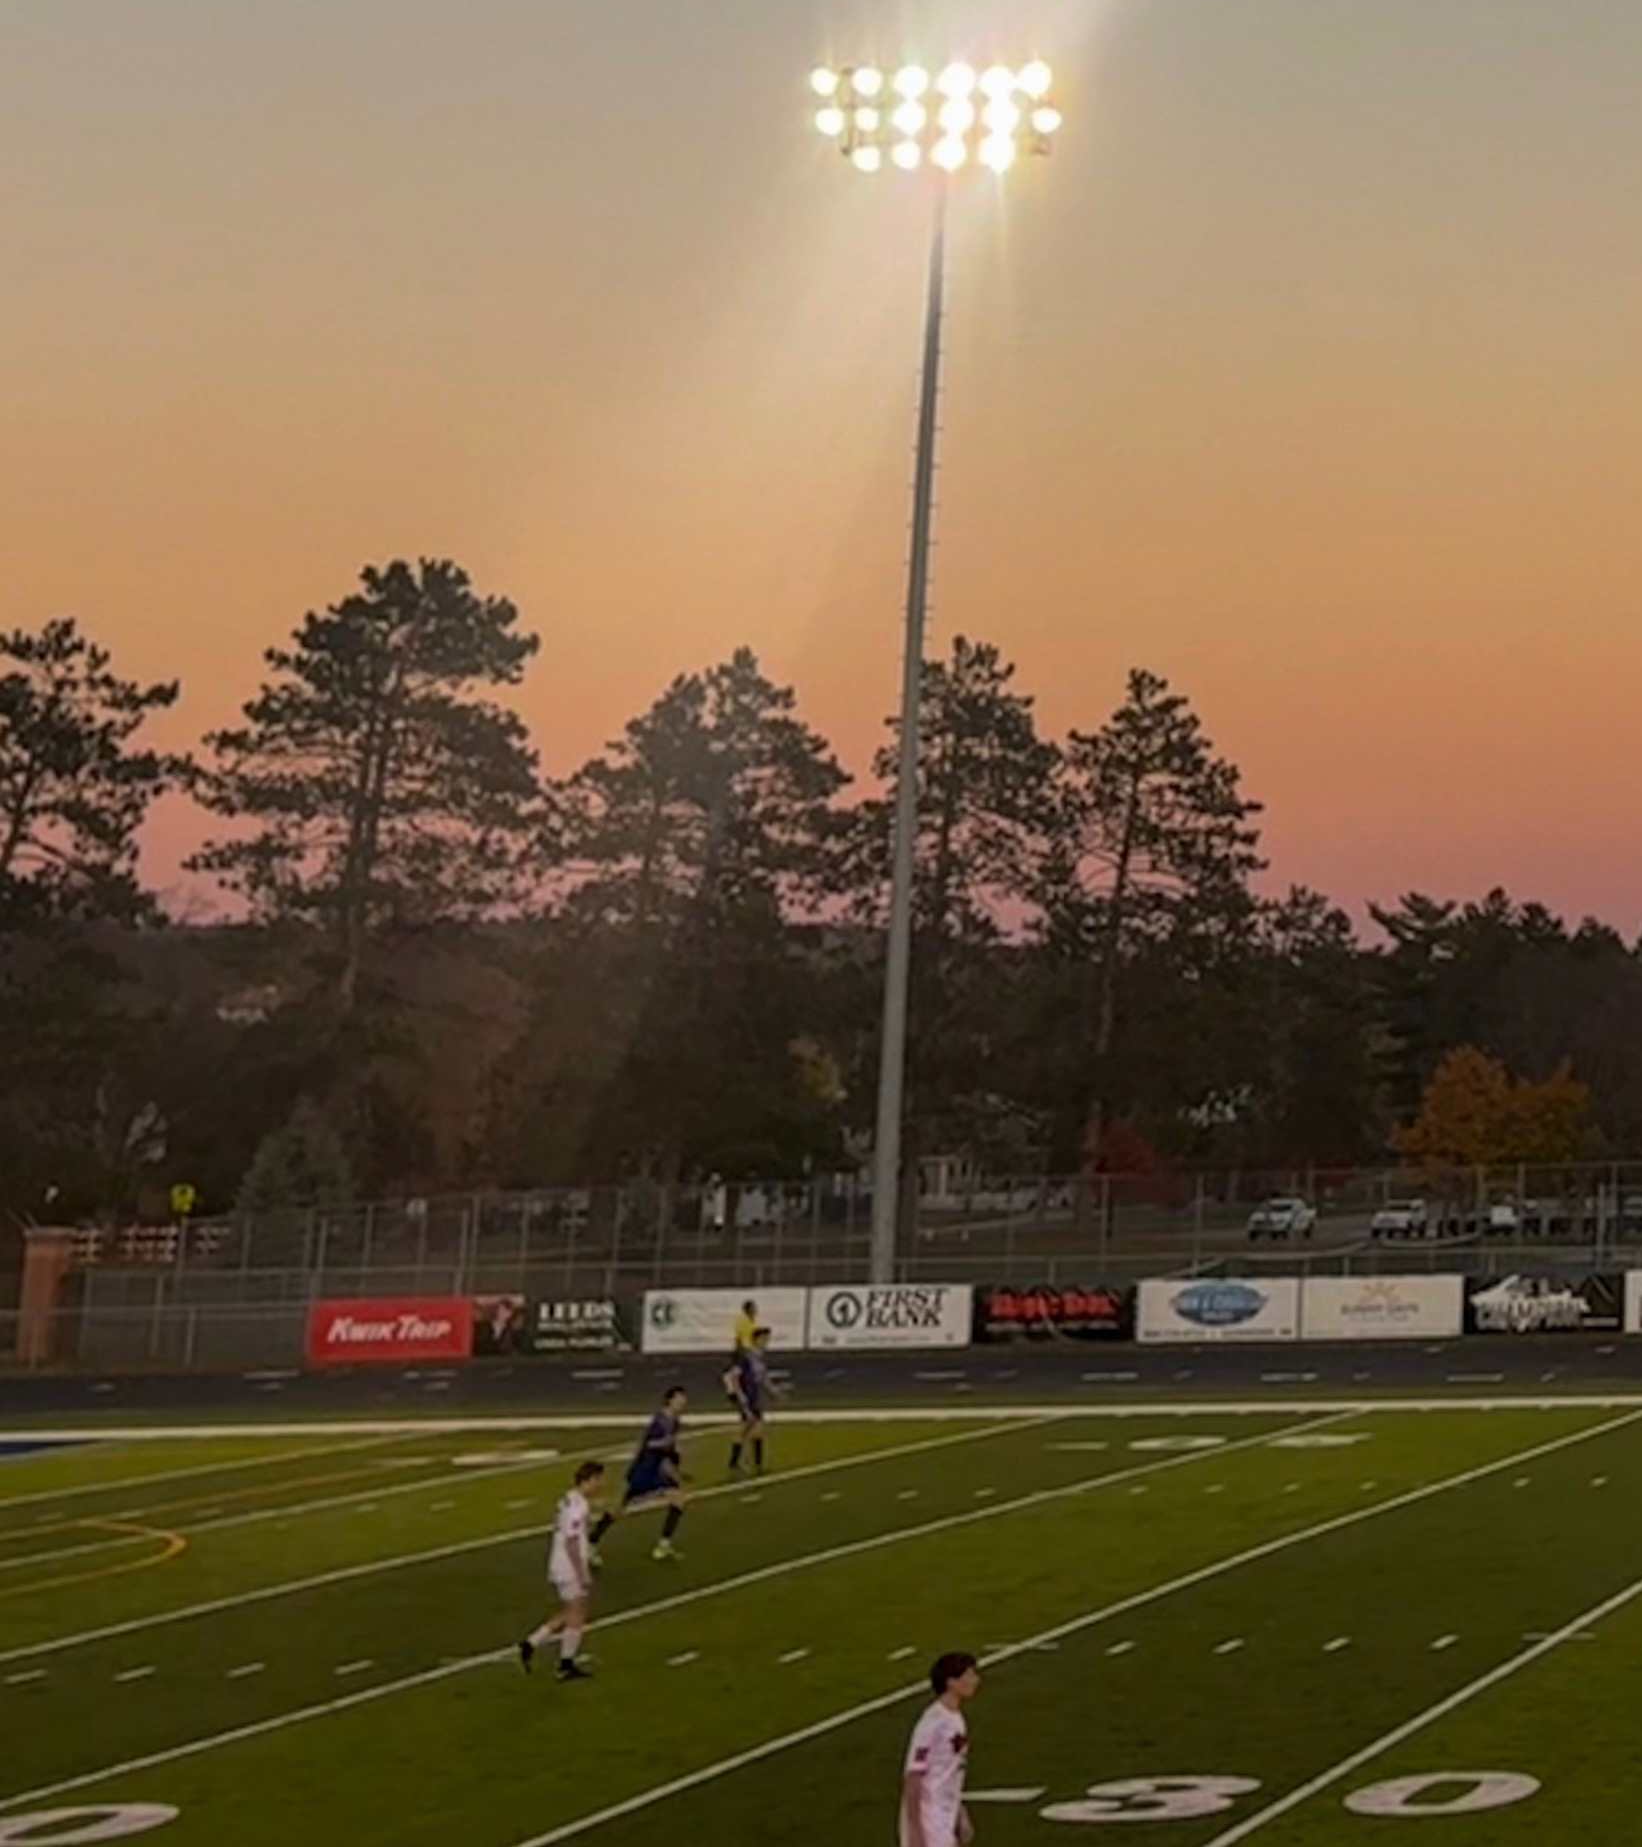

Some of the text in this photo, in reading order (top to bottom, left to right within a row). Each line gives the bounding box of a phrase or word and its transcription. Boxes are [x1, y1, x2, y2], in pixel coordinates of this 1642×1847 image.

[867, 1288, 950, 1310] FIRST
[540, 1301, 614, 1320] LEEDS
[866, 1308, 941, 1328] BANK
